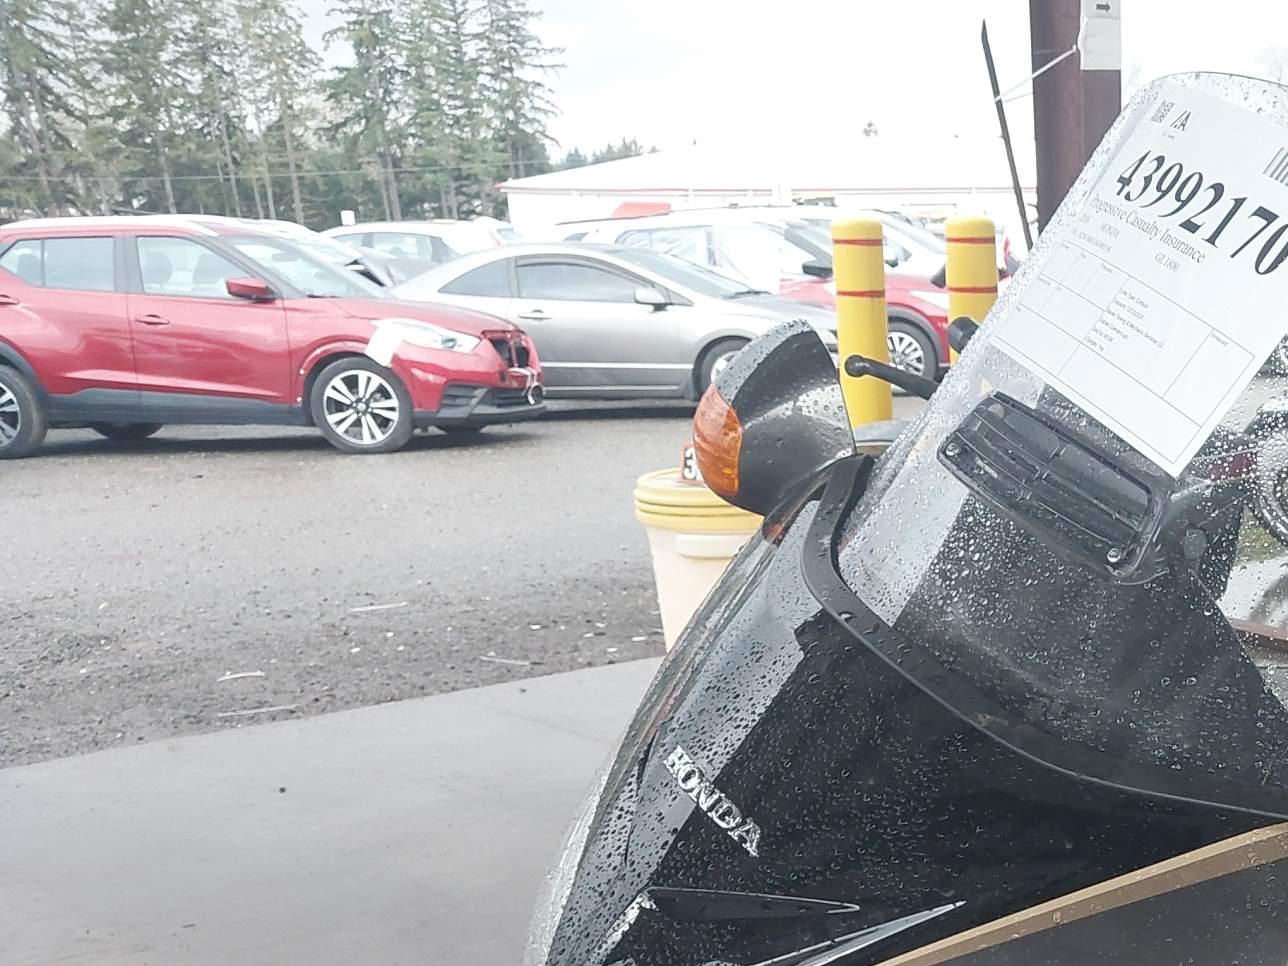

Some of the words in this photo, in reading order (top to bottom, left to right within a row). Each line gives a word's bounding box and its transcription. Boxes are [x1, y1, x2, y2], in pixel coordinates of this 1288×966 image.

[1125, 209, 1160, 241] Casualty
[1160, 227, 1206, 263] Insurance
[663, 745, 761, 858] HONDA
